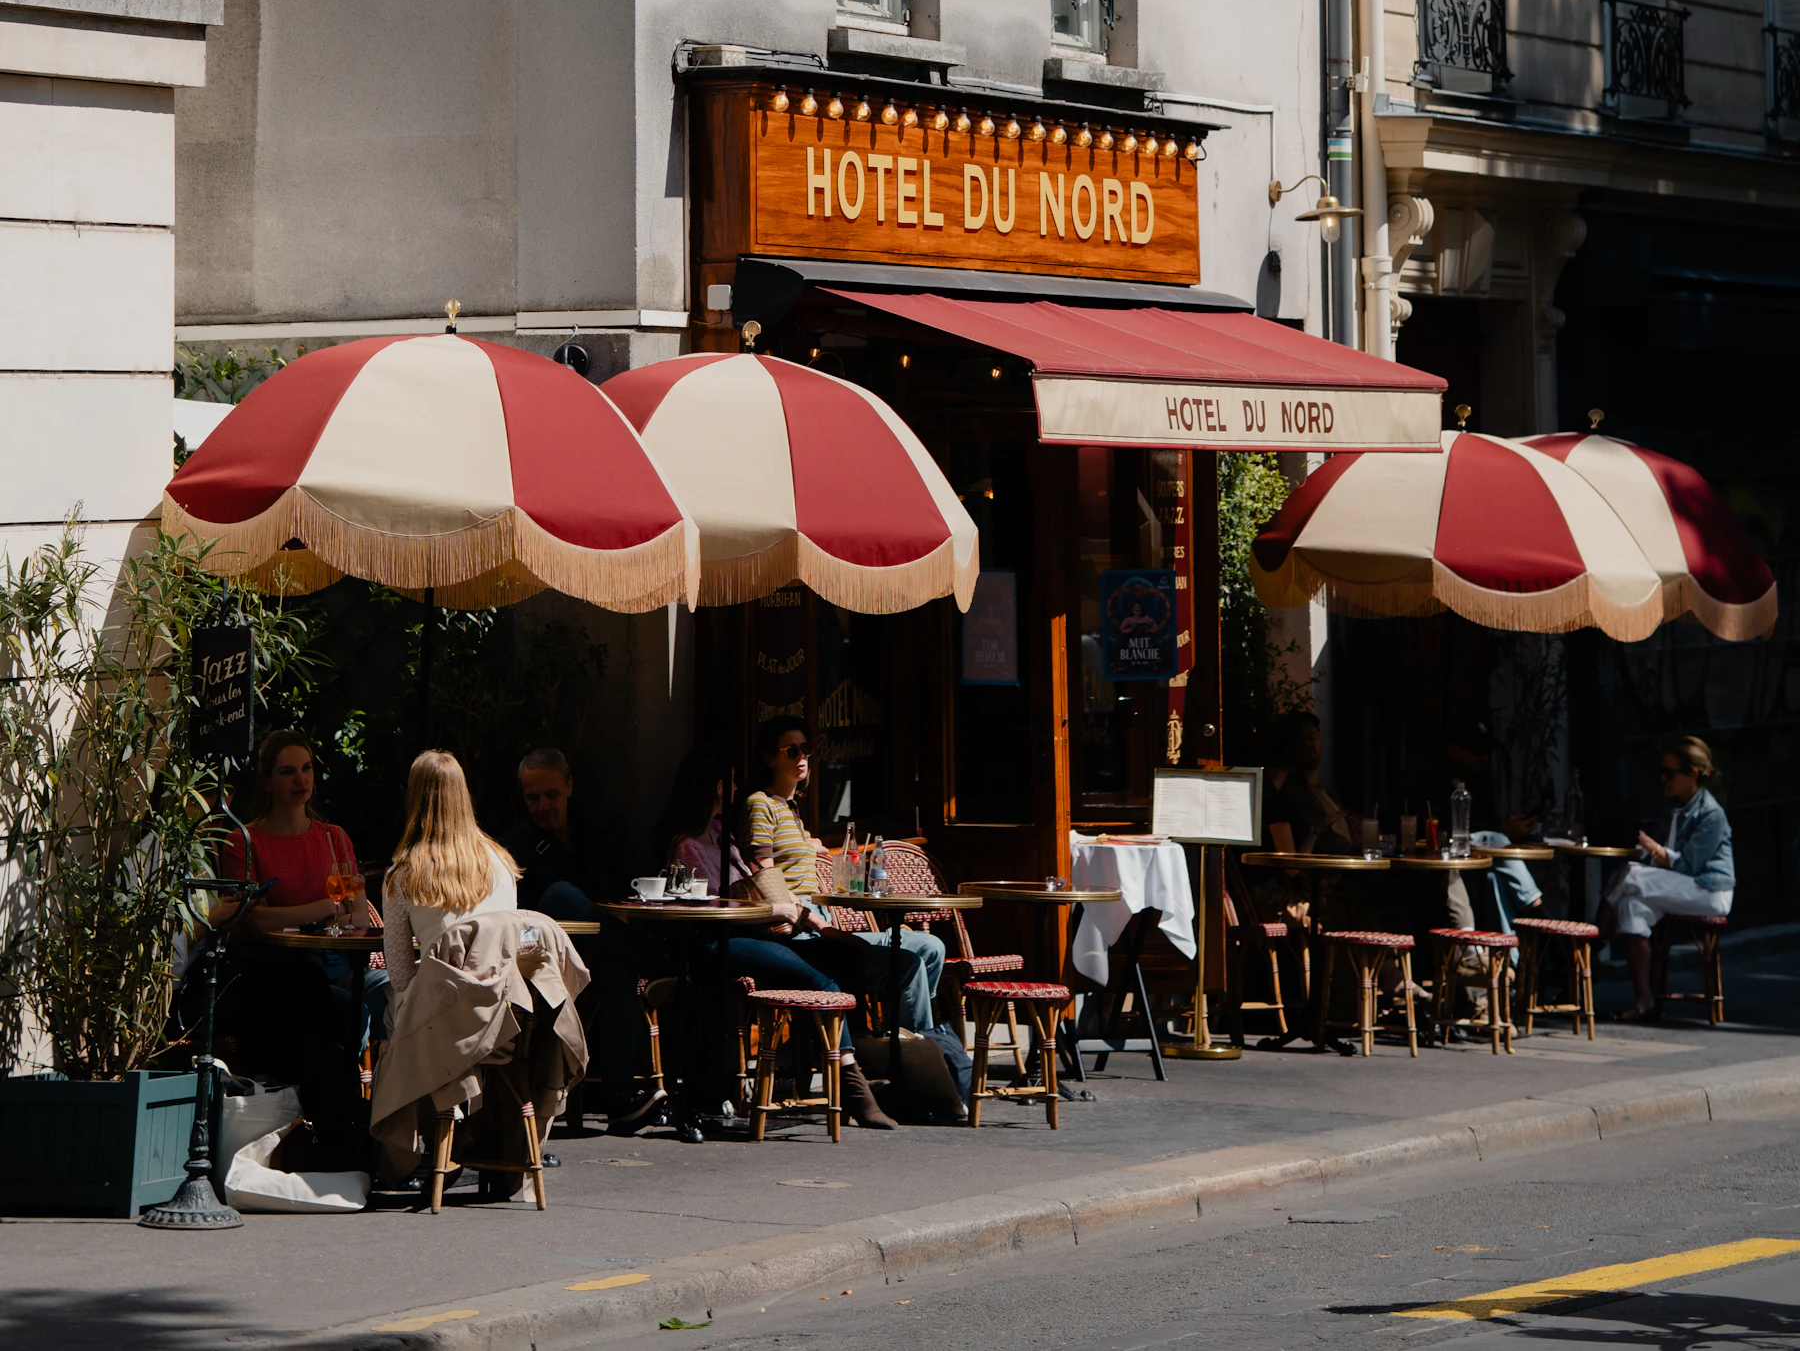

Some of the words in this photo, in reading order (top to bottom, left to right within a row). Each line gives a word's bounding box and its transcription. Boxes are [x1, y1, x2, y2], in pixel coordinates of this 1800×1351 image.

[806, 146, 945, 227] HOTEL
[963, 163, 1016, 234] DU
[1039, 171, 1155, 245] NORD
[1165, 397, 1227, 432] HOTEL
[1242, 399, 1266, 433] DU
[1281, 400, 1334, 434] NORD
[1120, 648, 1160, 660] BLANCHE
[1128, 636, 1151, 649] NUIT
[198, 650, 247, 697] Jazz
[757, 651, 778, 674] PLAT
[785, 647, 805, 673] JOUR
[228, 681, 242, 701] les
[818, 678, 851, 730] HOTEL
